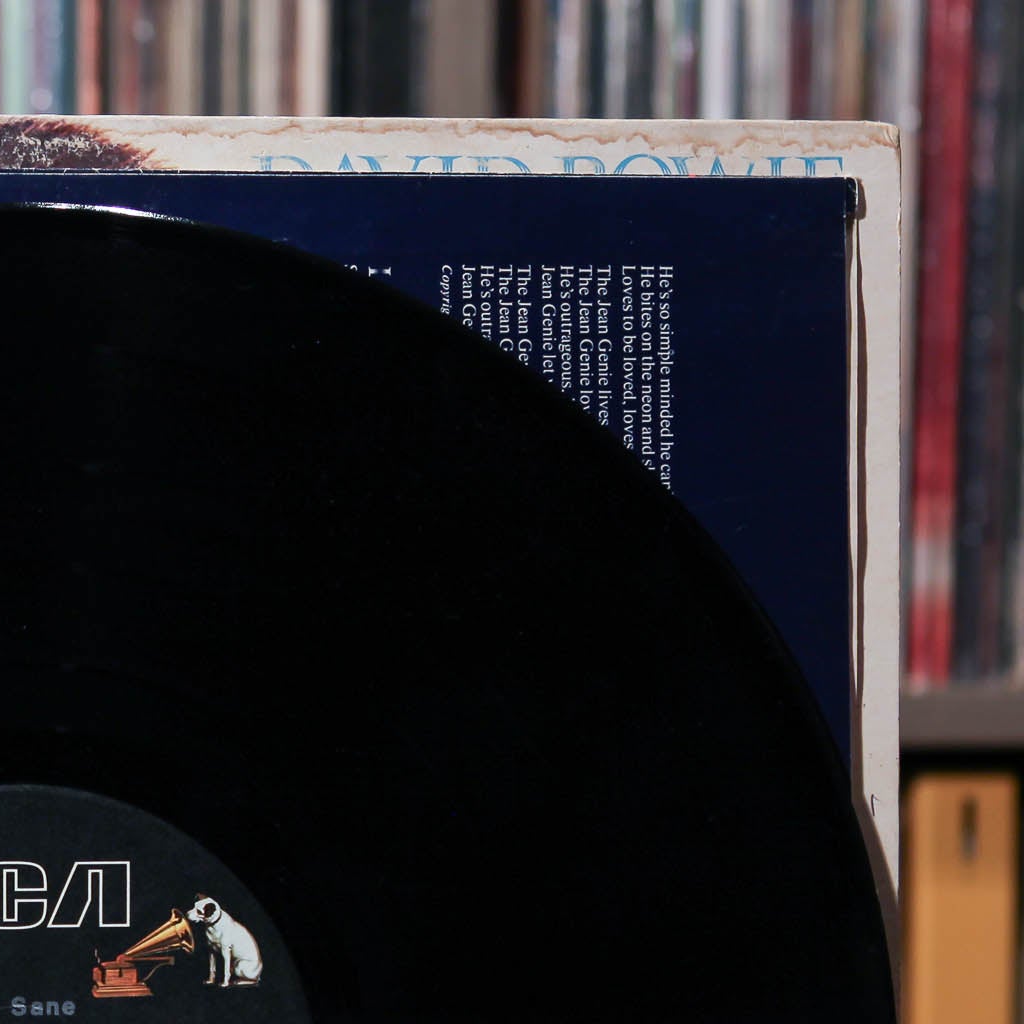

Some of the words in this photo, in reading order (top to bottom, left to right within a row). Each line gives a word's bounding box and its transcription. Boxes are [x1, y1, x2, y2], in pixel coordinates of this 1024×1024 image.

[462, 265, 475, 298] Jean
[481, 266, 494, 298] He's
[499, 265, 512, 294] The
[518, 265, 531, 295] The
[542, 265, 555, 298] Jean
[561, 266, 574, 298] He's
[579, 265, 592, 295] The
[597, 265, 611, 295] The
[622, 266, 635, 311] Loves
[641, 266, 654, 287] He
[660, 266, 673, 299] He's
[499, 300, 512, 333] Jean
[518, 300, 531, 333] Jean
[543, 304, 556, 350] Genie
[579, 300, 592, 333] Jean
[597, 300, 611, 333] Jean
[623, 316, 634, 330] to
[641, 293, 655, 328] bites
[660, 303, 670, 319] so
[559, 303, 572, 392] outrageous.
[623, 336, 636, 352] be
[642, 332, 651, 350] on
[659, 324, 673, 374] simple
[543, 355, 556, 373] let
[580, 339, 593, 385] Genie
[599, 339, 612, 385] Genie
[642, 357, 655, 380] the
[622, 358, 636, 404] loved,
[599, 391, 612, 425] lives
[642, 386, 651, 422] neon
[660, 379, 674, 436] minded
[624, 410, 636, 449] loves
[642, 427, 655, 454] and
[661, 442, 674, 460] he
[12, 997, 75, 1016] Sane
